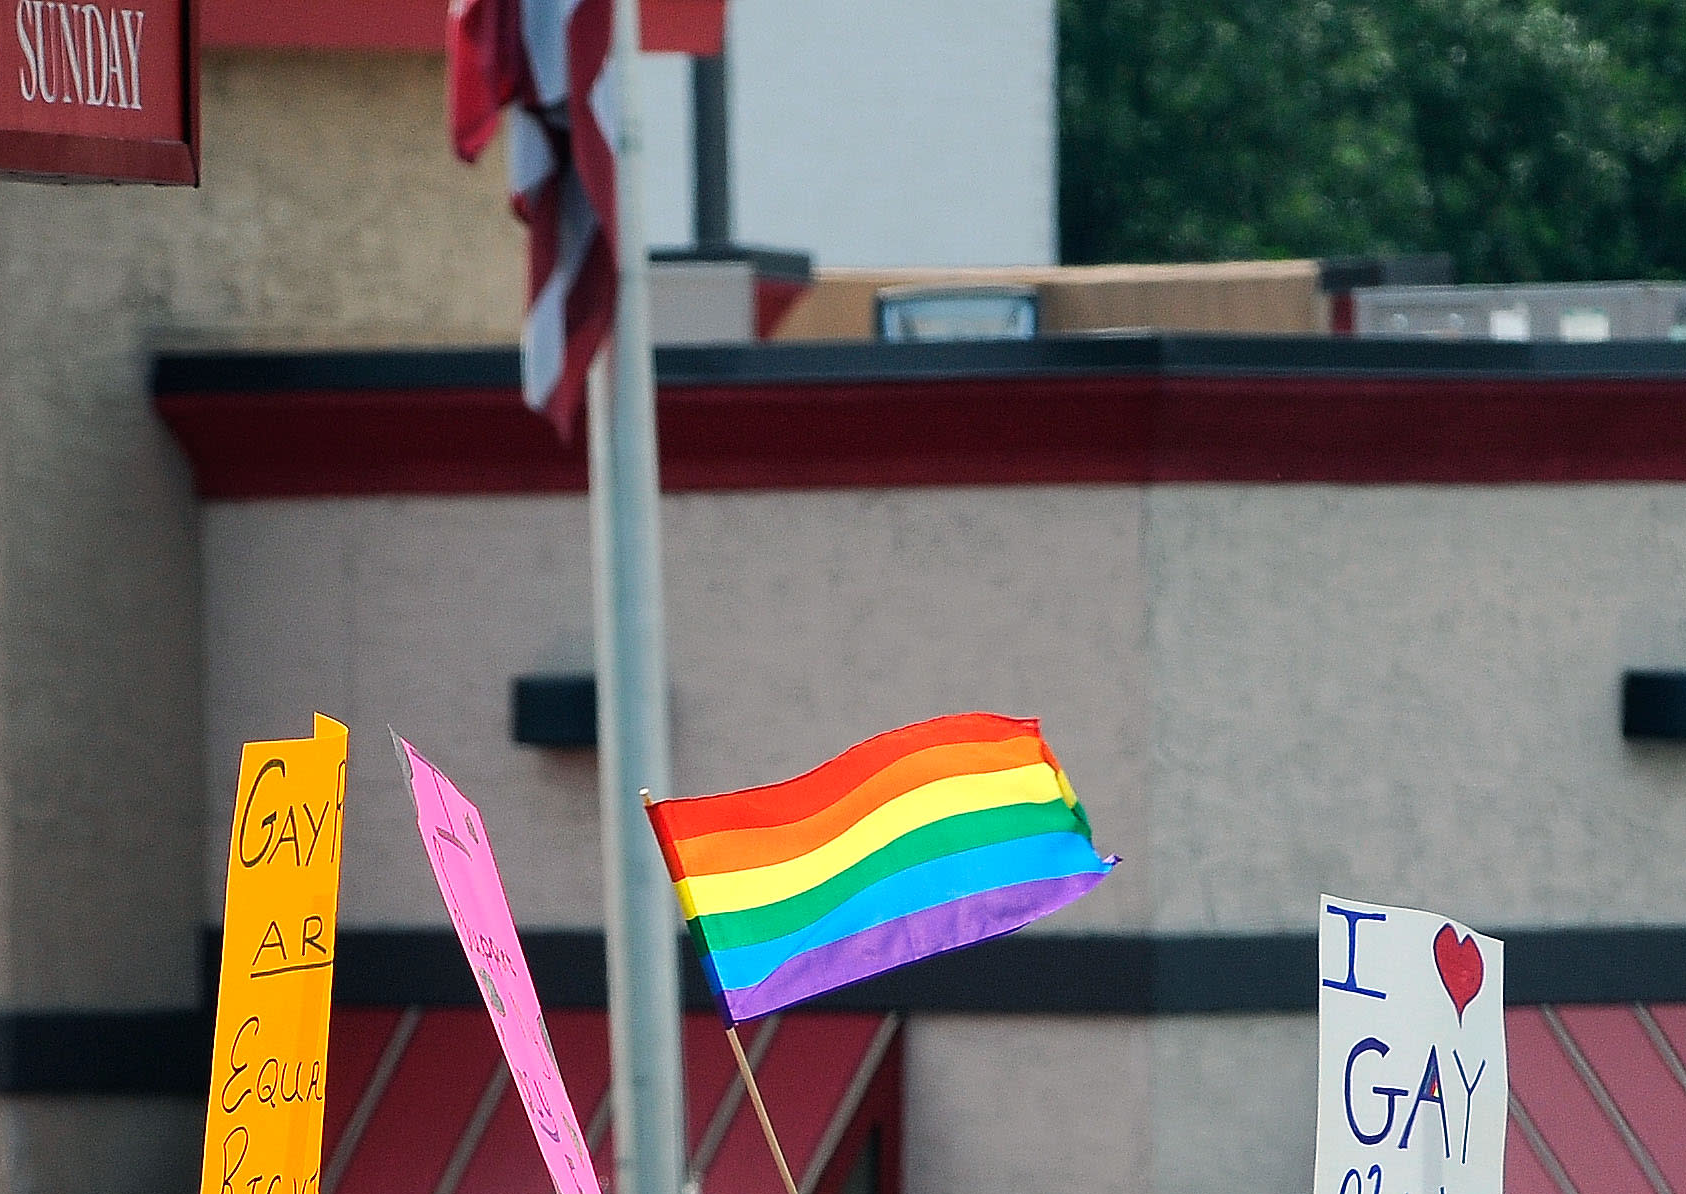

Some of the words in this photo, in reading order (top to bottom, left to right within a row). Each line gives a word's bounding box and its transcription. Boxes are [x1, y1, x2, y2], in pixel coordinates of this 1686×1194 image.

[16, 1, 144, 109] SUNDAY
[239, 759, 329, 868] GAY
[1322, 904, 1386, 999] I
[1344, 1036, 1486, 1165] GAY
